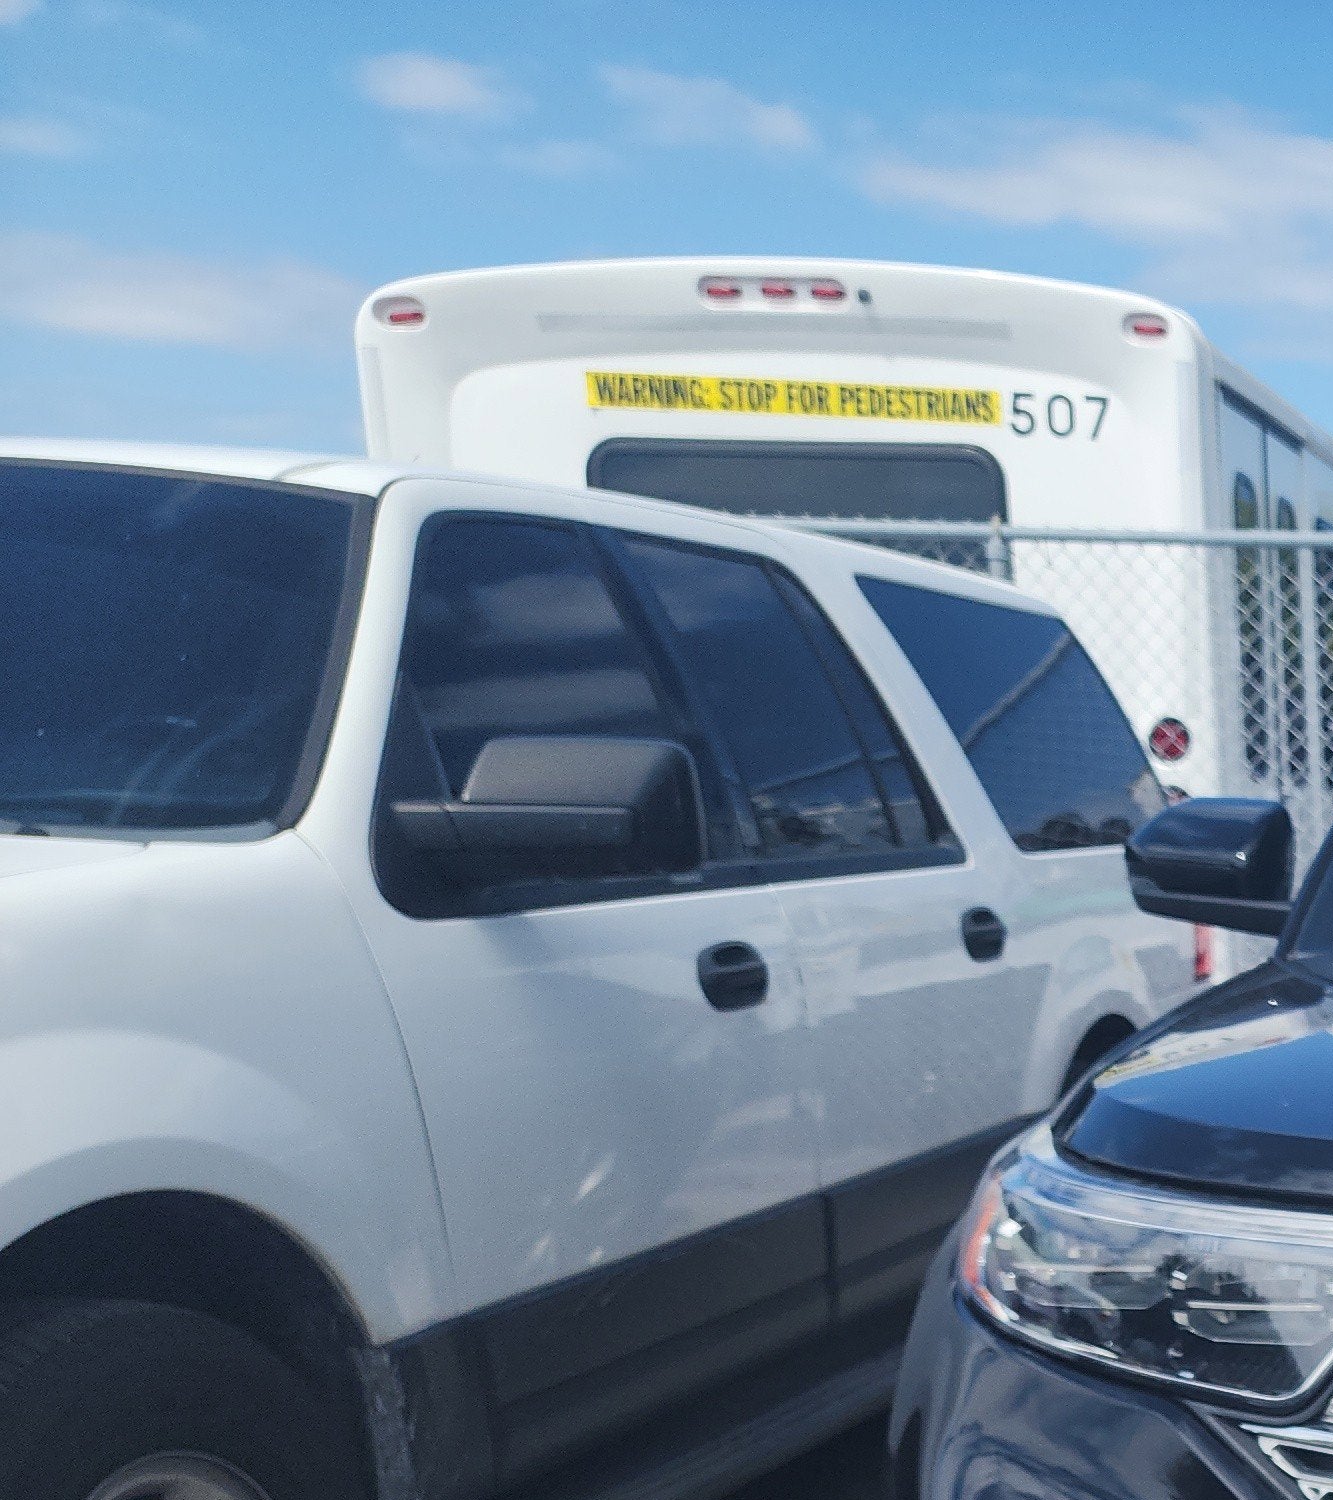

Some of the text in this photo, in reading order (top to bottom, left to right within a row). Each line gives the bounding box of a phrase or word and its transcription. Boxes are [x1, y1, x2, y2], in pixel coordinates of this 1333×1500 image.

[718, 379, 777, 411] STOP
[786, 381, 831, 413] FOR
[839, 384, 996, 424] PEDESTRIANS
[1010, 391, 1110, 441] 507
